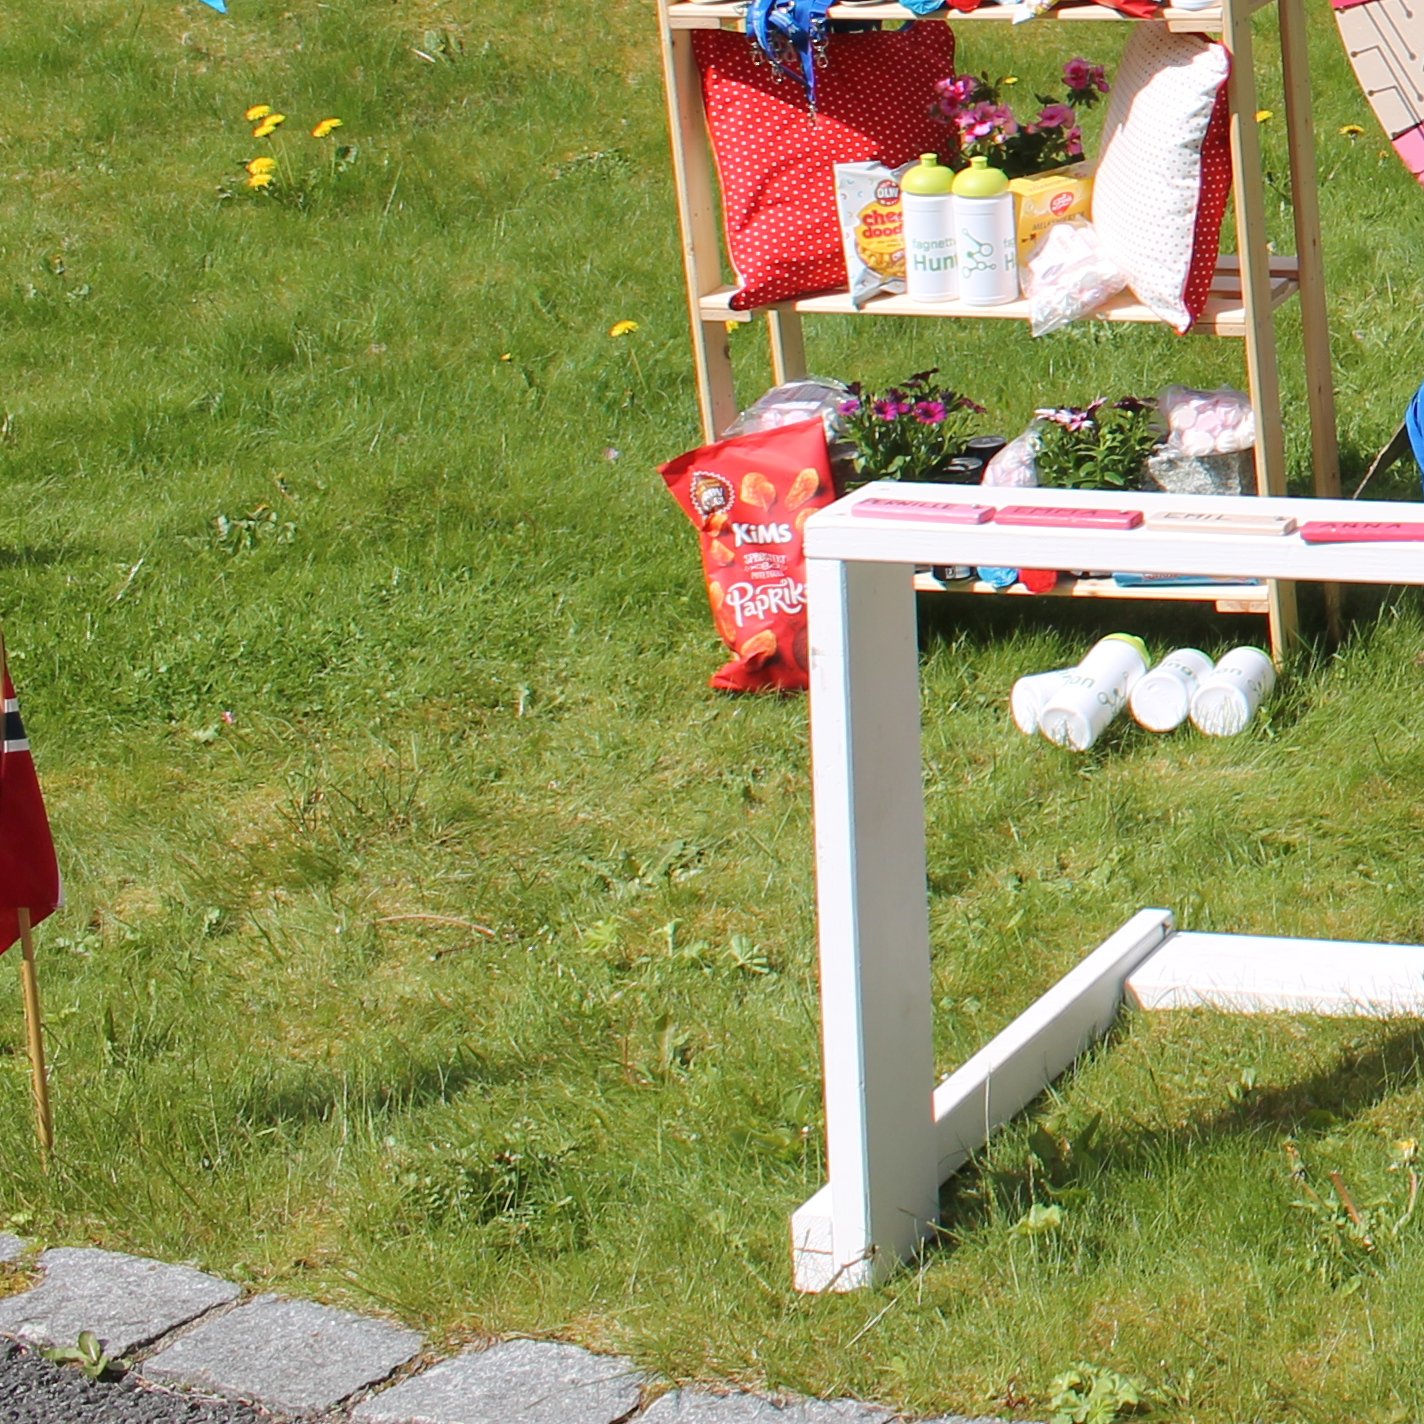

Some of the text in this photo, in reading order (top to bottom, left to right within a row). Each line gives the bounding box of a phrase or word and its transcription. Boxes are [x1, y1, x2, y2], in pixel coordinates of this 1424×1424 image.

[859, 498, 951, 510] PERNILLE
[1013, 506, 1098, 516] EMMA
[1163, 512, 1232, 521] EMIL
